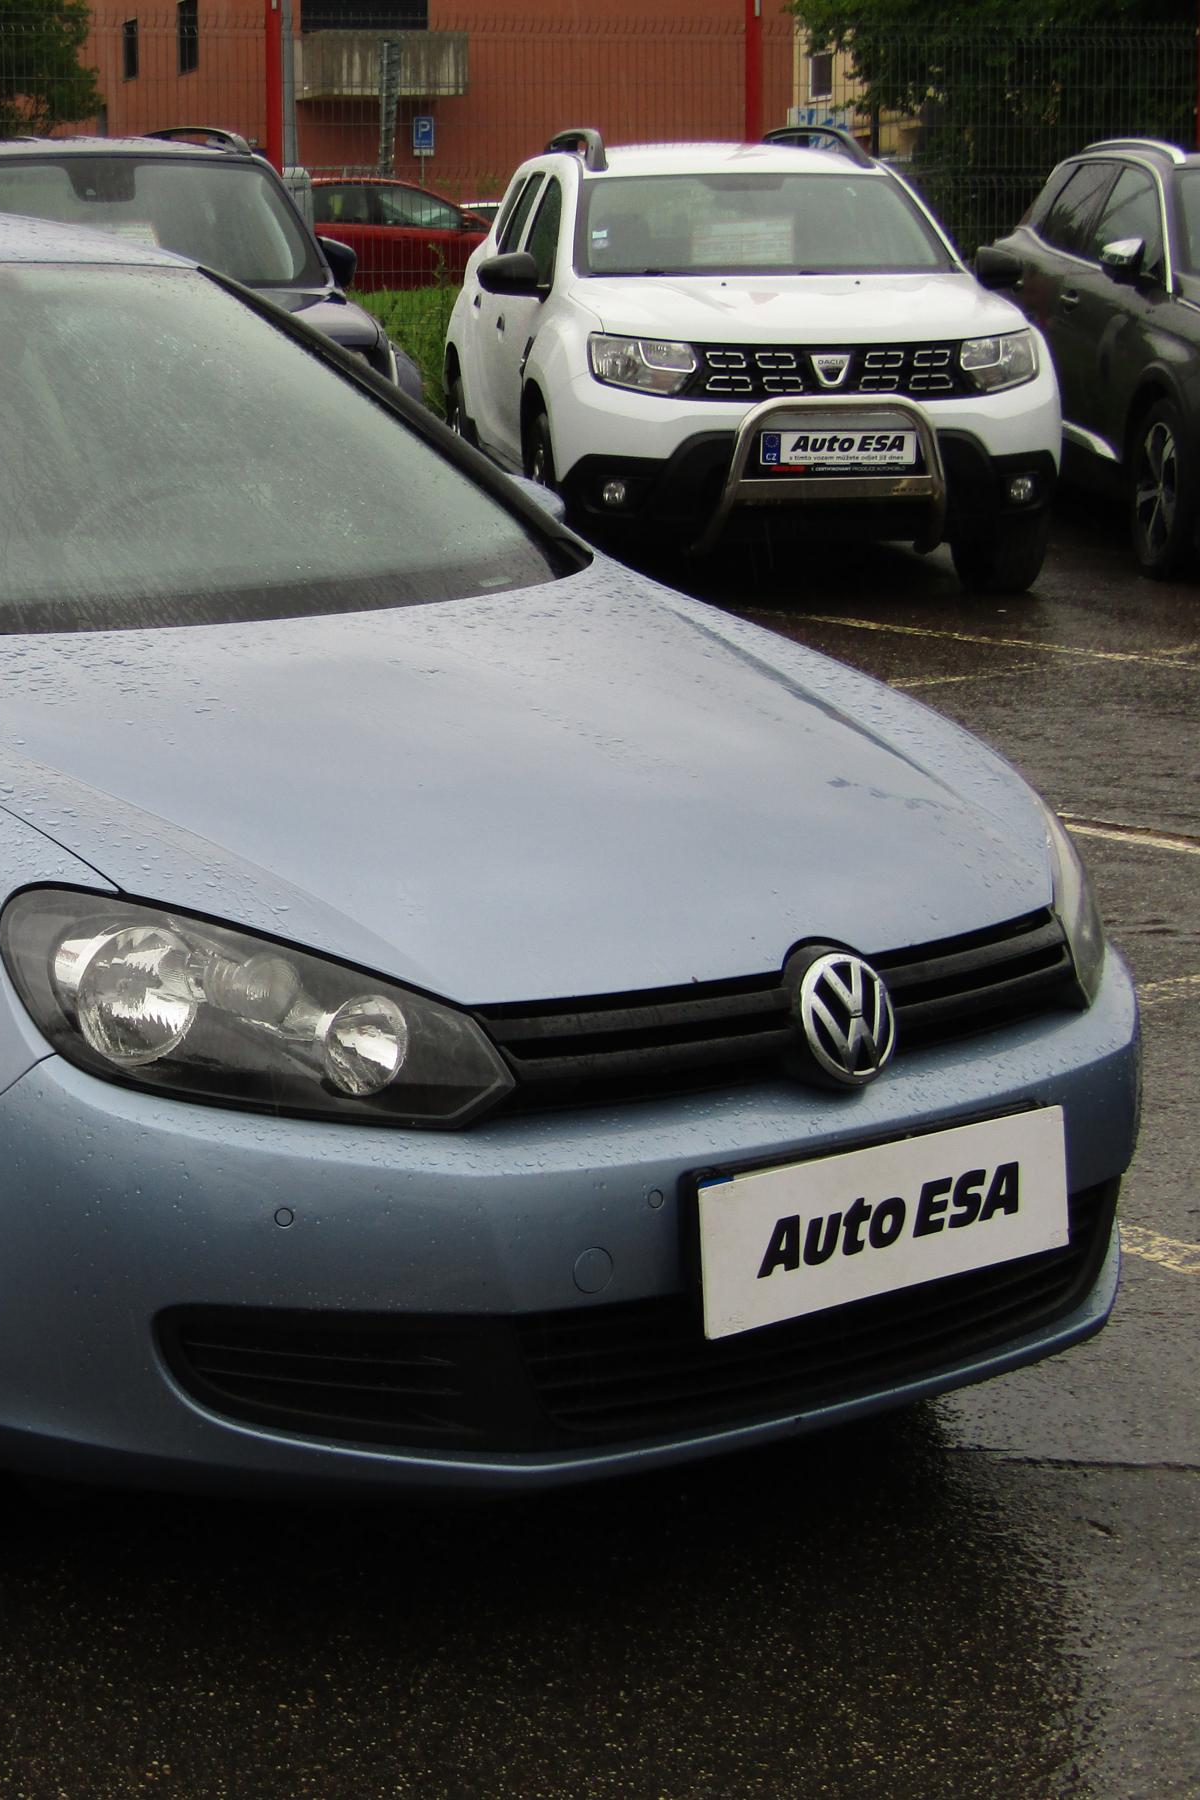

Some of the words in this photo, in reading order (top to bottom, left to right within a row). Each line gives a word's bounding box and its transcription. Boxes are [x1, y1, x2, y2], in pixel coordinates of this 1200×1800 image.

[418, 121, 431, 139] P
[790, 435, 855, 452] Auto
[857, 435, 905, 452] ESA
[765, 452, 777, 461] CZ
[801, 953, 894, 1085] VW
[757, 1197, 906, 1279] Auto
[913, 1161, 1019, 1238] ESA
